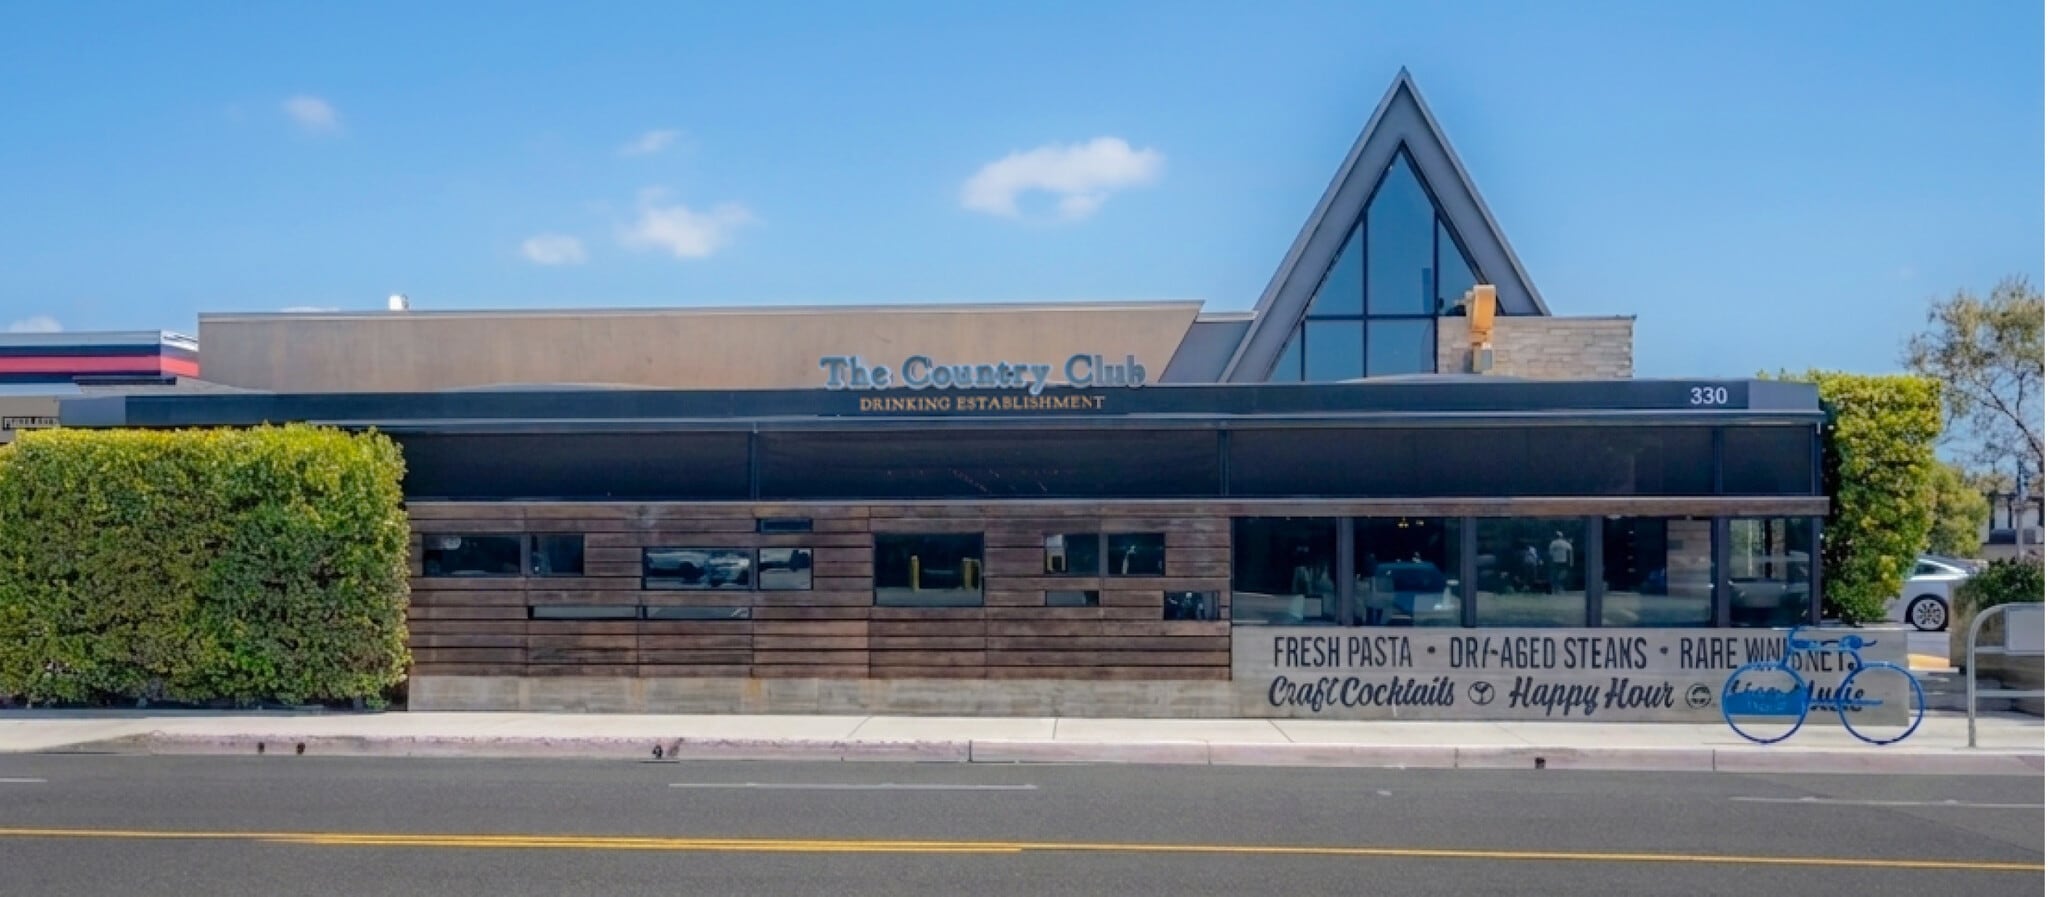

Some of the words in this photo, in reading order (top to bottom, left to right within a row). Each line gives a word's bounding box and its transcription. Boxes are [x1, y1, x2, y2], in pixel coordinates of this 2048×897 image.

[820, 355, 892, 390] The
[901, 355, 1050, 394] Country
[1064, 354, 1146, 387] Club
[860, 397, 950, 411] DRINKING
[957, 395, 1105, 410] ESTABLISHMENT
[1690, 386, 1728, 405] 330
[1274, 636, 1340, 668] FRESH
[1348, 636, 1413, 668] PASTA
[1563, 636, 1647, 669] STEAKS
[1680, 637, 1738, 669] RARE
[1269, 675, 1339, 712] Craft
[1341, 675, 1455, 706] Cocktails
[1509, 676, 1600, 716] Happy
[1605, 677, 1674, 708] Hour
